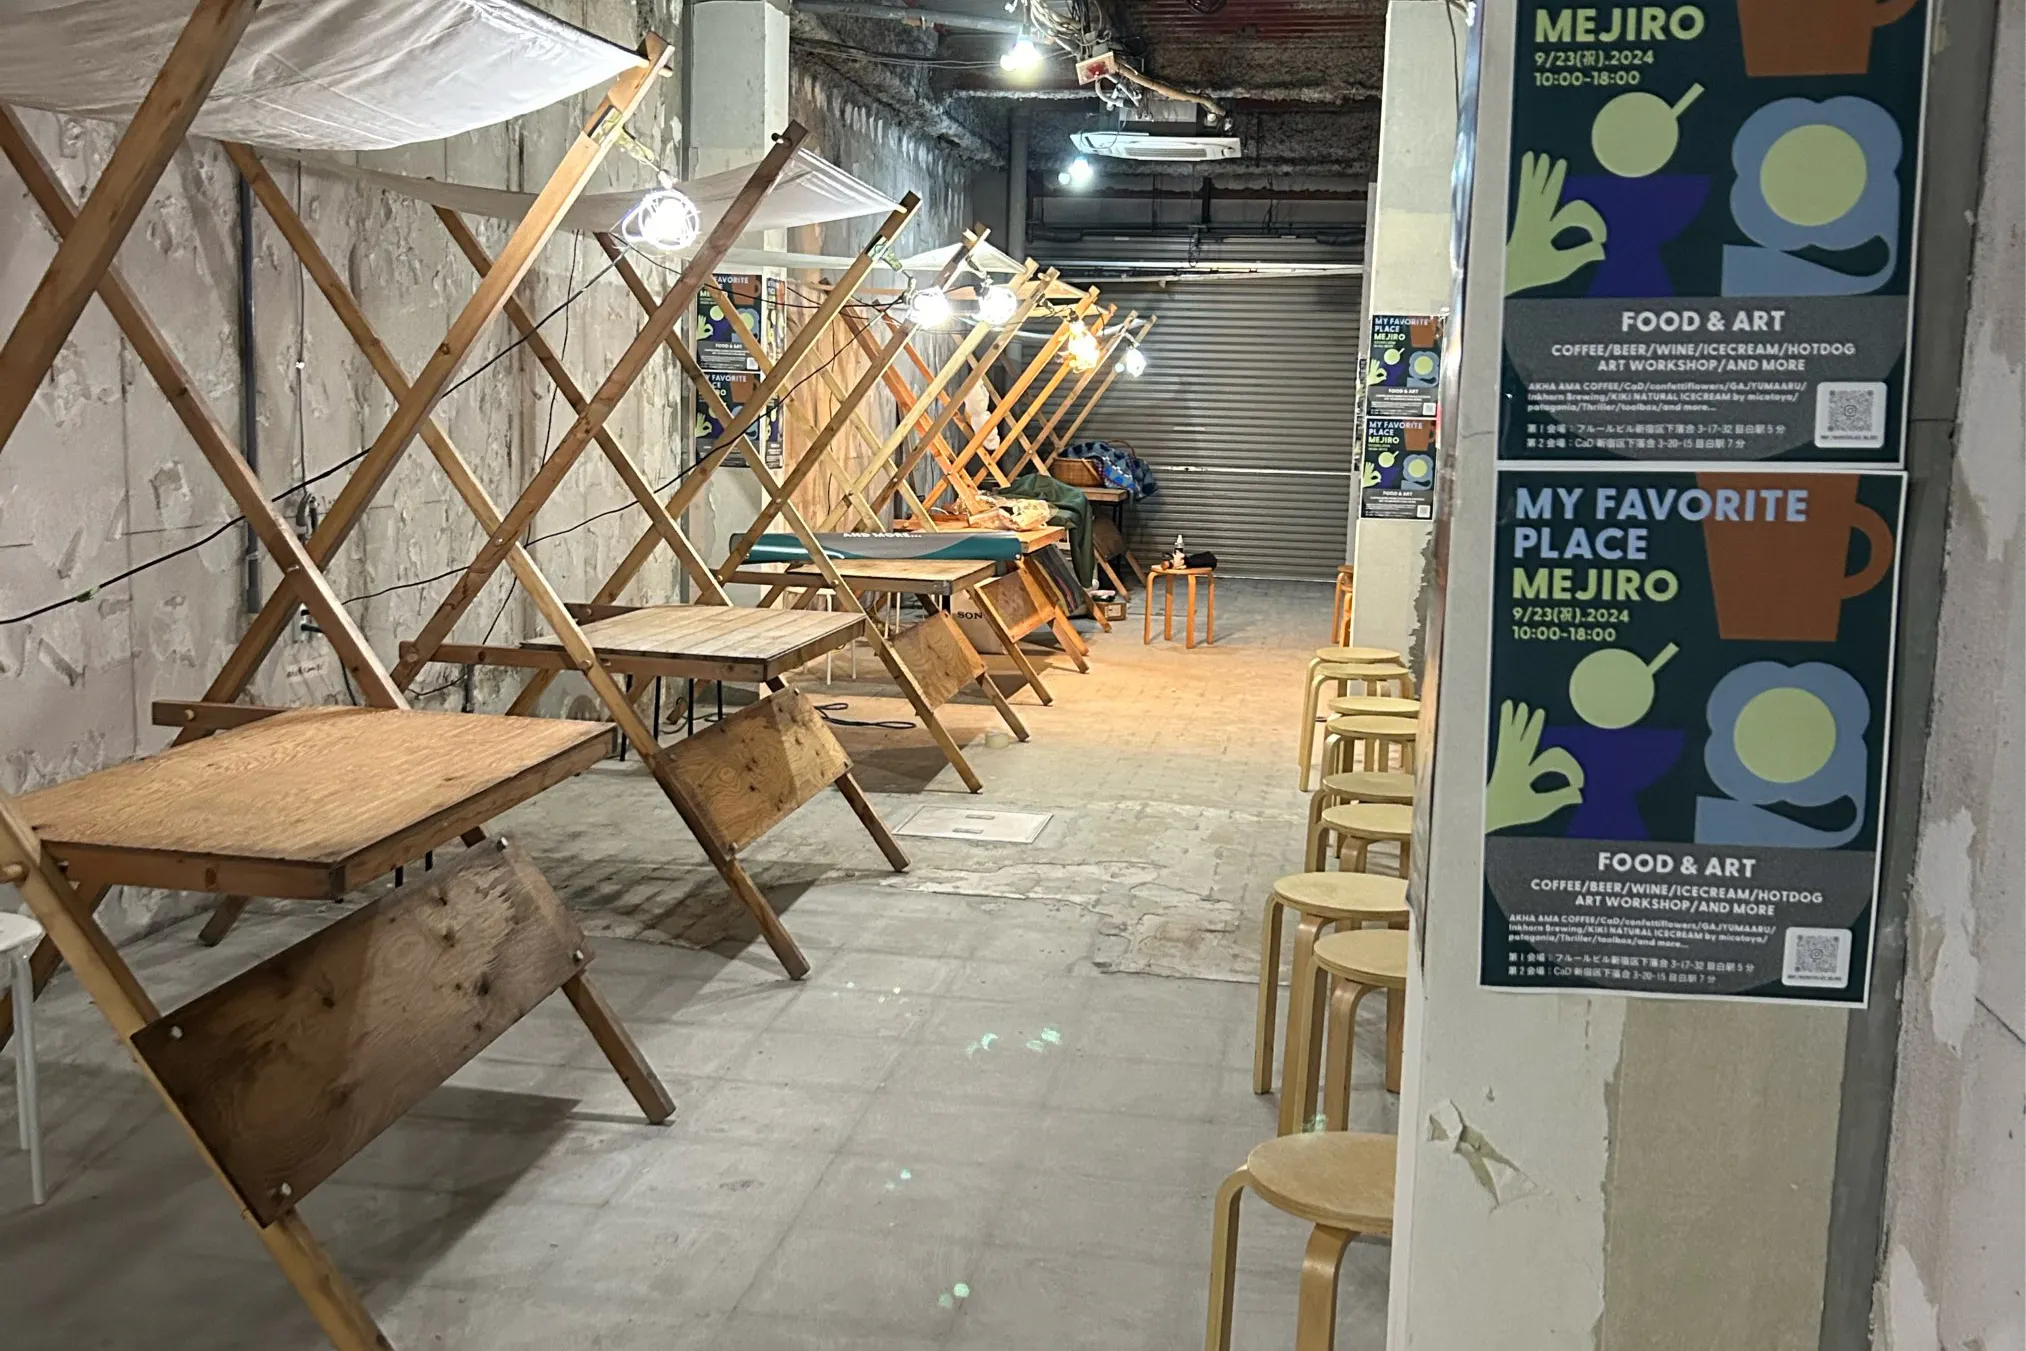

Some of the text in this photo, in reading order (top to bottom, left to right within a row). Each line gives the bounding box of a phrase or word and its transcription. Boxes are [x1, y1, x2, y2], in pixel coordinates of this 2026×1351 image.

[1534, 5, 1706, 43] MEJIRO
[1534, 71, 1641, 87] 10:00-18:00
[1621, 310, 1785, 332] FOOD & ART
[1374, 333, 1406, 341] MEJIRO
[1551, 343, 1857, 358] COFFEE/BEER/WINE/ICECREAM/HOTDOG
[1597, 359, 1806, 373] ART WORKSHOP/AND MORE
[1368, 436, 1400, 444] MEJIRO
[1515, 487, 1809, 522] MY FAVORITE
[1513, 527, 1648, 560] PLACE
[1512, 567, 1679, 602] MEJIRO
[957, 611, 983, 620] SON
[1512, 626, 1617, 642] 10:00-18:00
[1597, 852, 1757, 878] FOOD & ART
[1530, 878, 1824, 904] COFFEE/BEER/WINE/ICECREAM/HOTDOG
[1575, 895, 1776, 916] ART WORKSHOP/AND MORE
